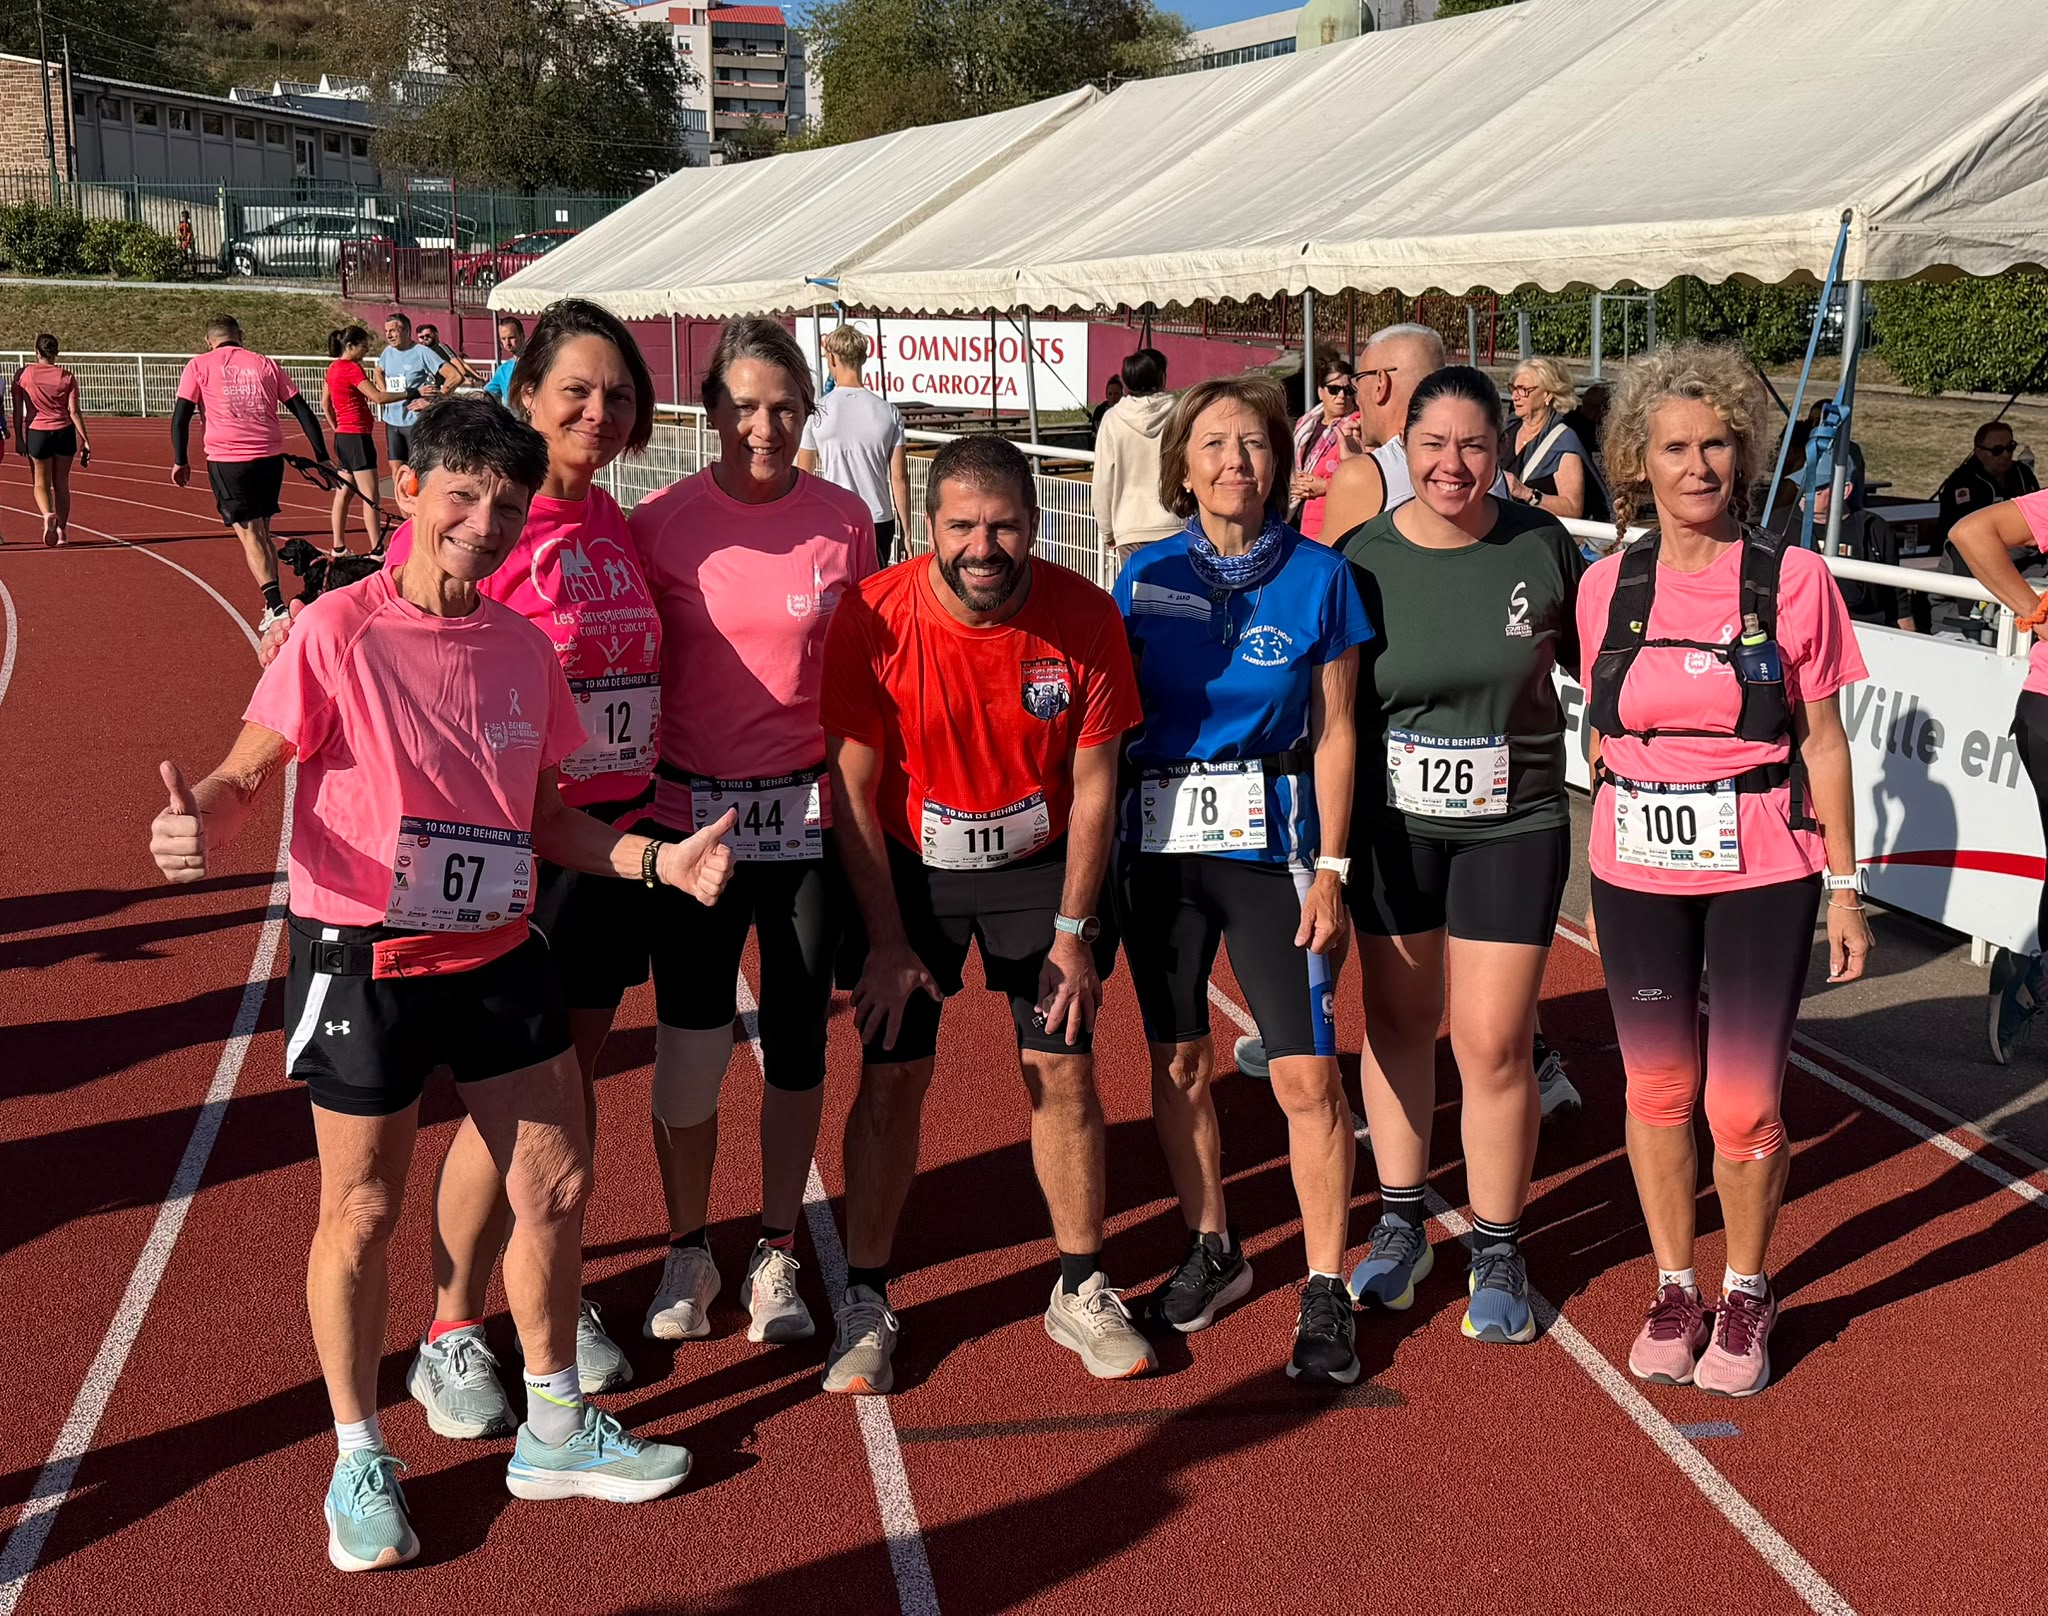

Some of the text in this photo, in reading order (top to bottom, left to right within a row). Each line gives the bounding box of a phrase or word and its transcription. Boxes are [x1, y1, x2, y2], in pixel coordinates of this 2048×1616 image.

[863, 371, 1018, 396] Aldo CARROZZA
[552, 611, 575, 625] Les
[580, 622, 646, 637] contre le cancer
[586, 675, 647, 688] 10 KM DE BEHREN
[604, 701, 631, 745] 12
[1845, 682, 2022, 790] Ville en
[1410, 733, 1420, 743] 10
[1420, 736, 1436, 745] KM
[1437, 738, 1450, 746] DE
[1451, 737, 1489, 747] BEHREN
[1418, 758, 1474, 795] 126
[945, 800, 1026, 820] 10 KM DE BEHREN
[1183, 786, 1219, 827] 78
[425, 821, 437, 832] 10
[439, 823, 456, 834] KM
[458, 826, 472, 837] DE
[473, 828, 512, 842] BEHREN
[1641, 804, 1697, 845] 100
[964, 825, 1004, 853] 111
[443, 852, 486, 903] 67
